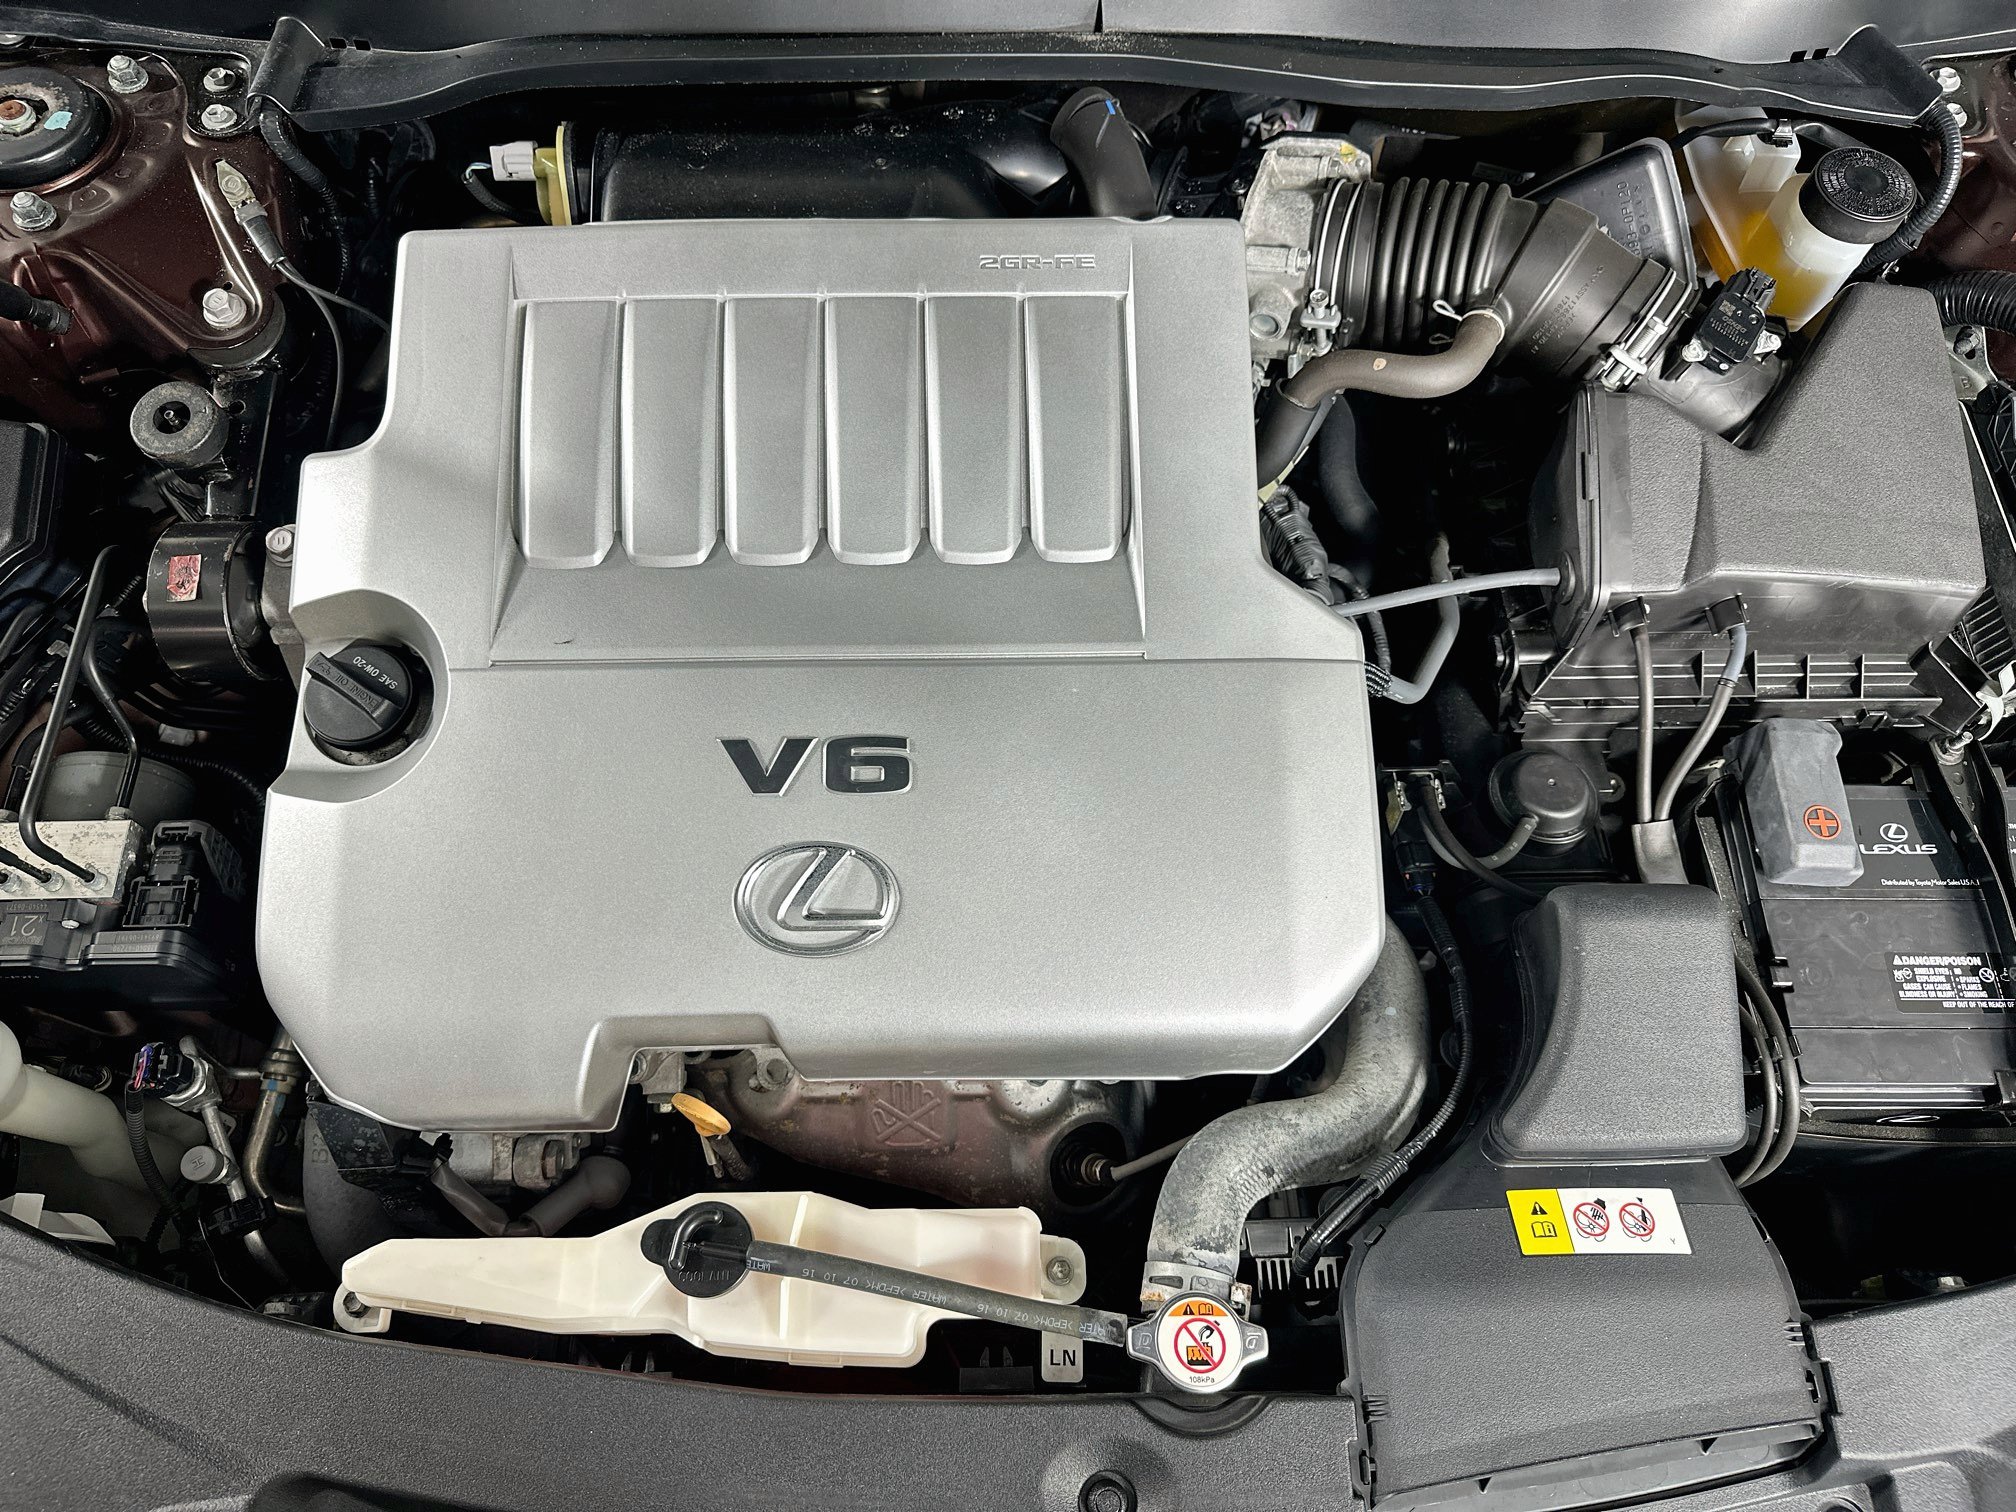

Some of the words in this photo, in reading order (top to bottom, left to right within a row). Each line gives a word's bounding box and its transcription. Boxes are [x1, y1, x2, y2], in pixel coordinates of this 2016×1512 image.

[979, 254, 1097, 270] 2GR-FE
[1722, 315, 1748, 333] DENSO
[352, 656, 380, 677] 0W-20
[378, 673, 398, 690] SAE
[716, 734, 913, 797] V6
[1858, 843, 1938, 855] LEXUS
[1880, 878, 1908, 886] Distributed
[1908, 878, 1915, 887] by
[1915, 878, 1931, 887] Toyota
[1931, 878, 1947, 887] Motor
[1947, 878, 1960, 886] Sales
[1901, 955, 1982, 966] DANGER/POISON
[1961, 983, 1982, 991] FLAMES
[801, 1268, 815, 1278] 16
[913, 1289, 947, 1305] WATER
[976, 1303, 989, 1314] 16
[1050, 1349, 1076, 1367] LN
